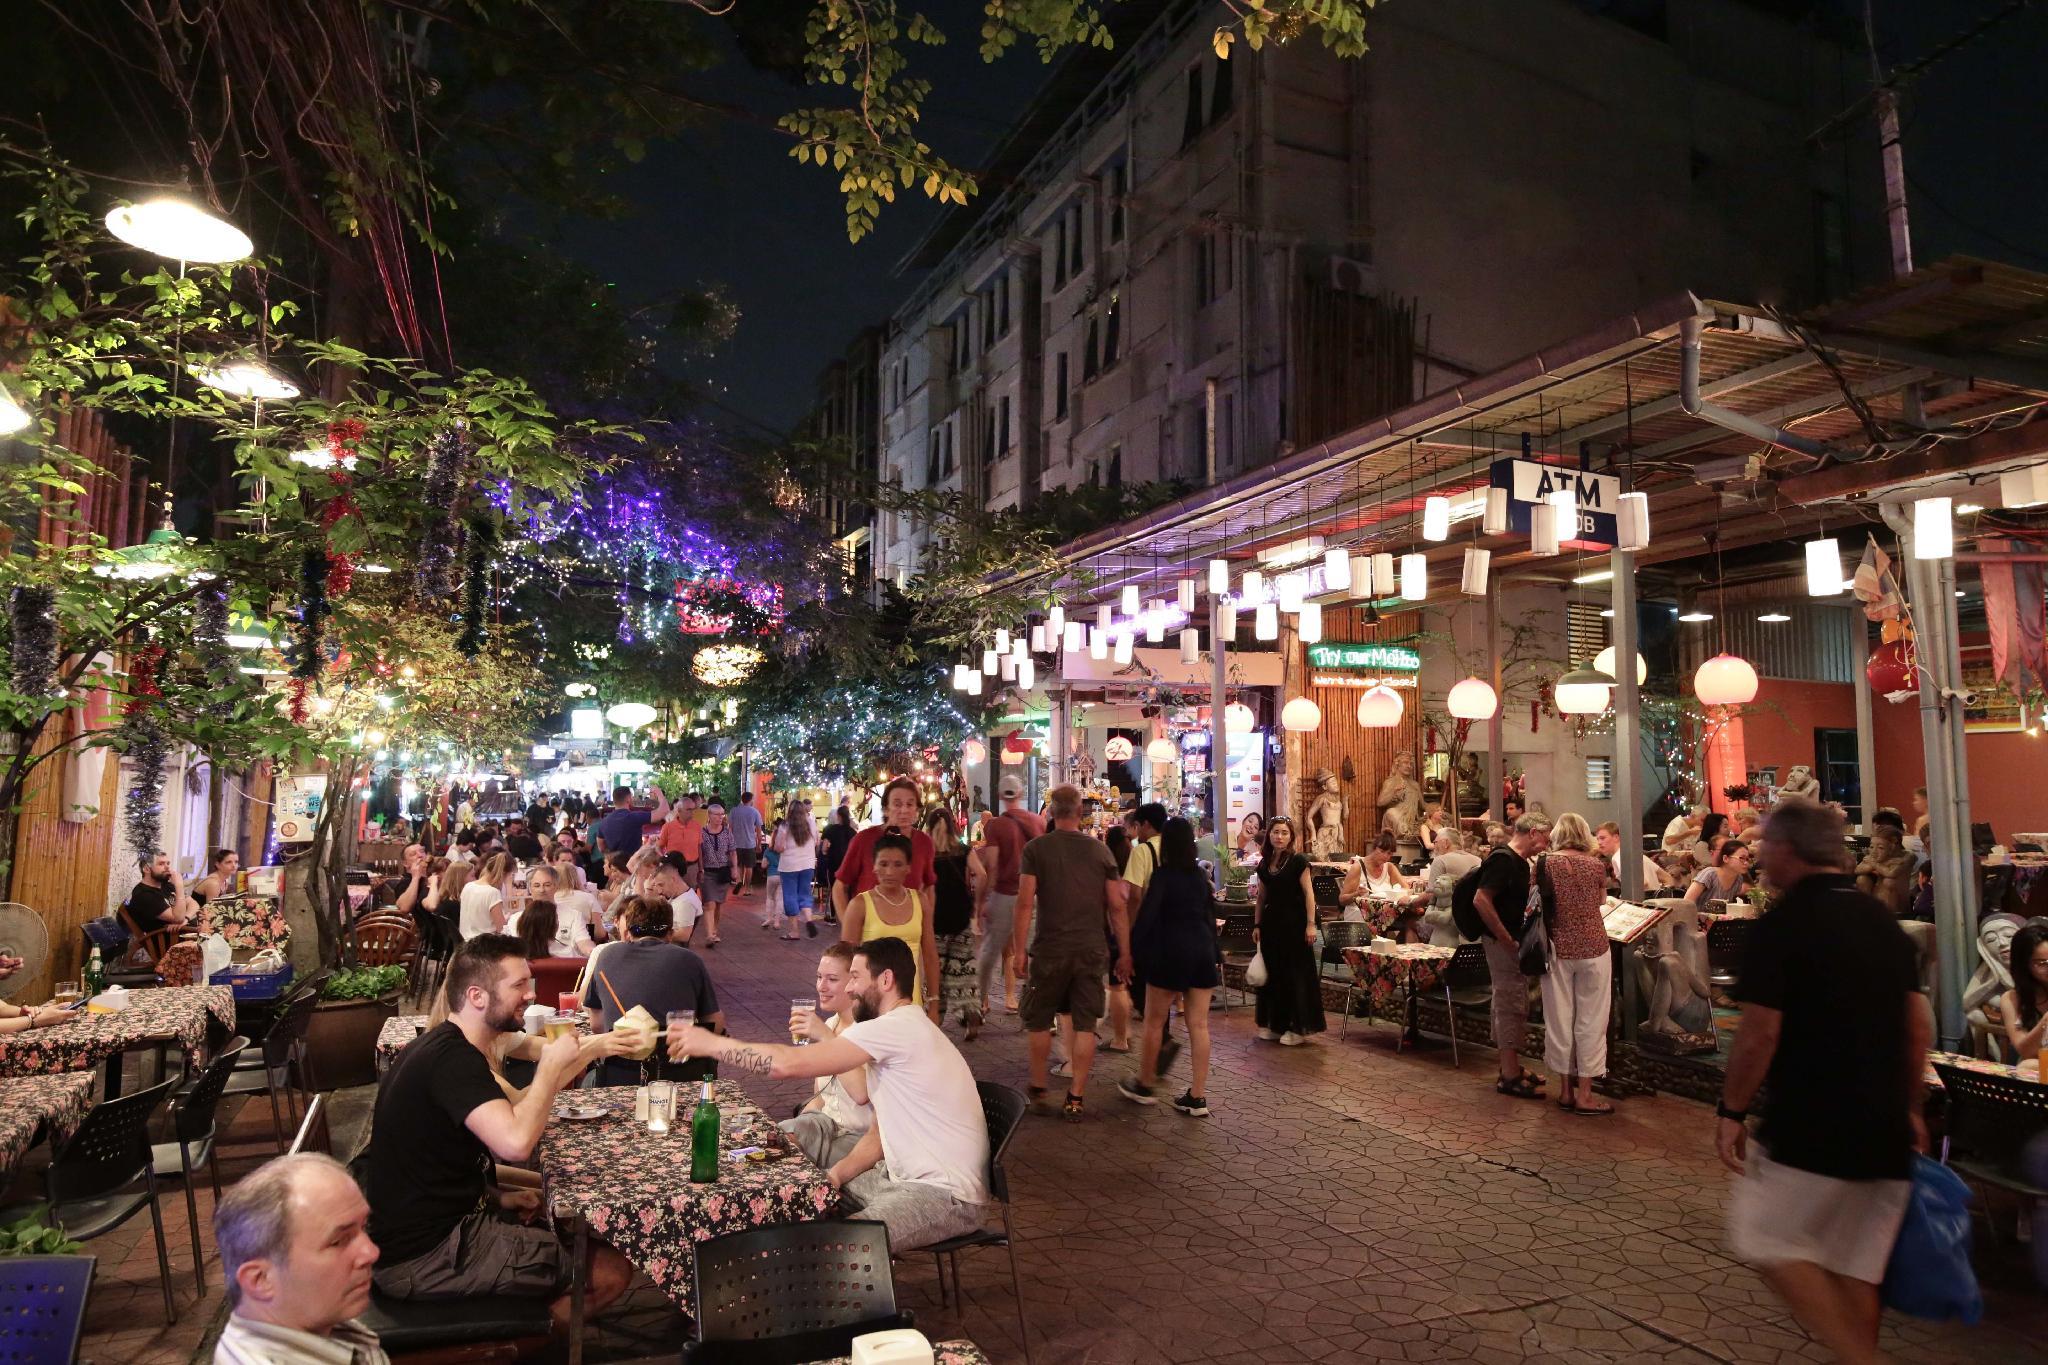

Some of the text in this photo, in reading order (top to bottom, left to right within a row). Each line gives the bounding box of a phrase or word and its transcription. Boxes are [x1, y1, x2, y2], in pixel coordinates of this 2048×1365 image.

[1536, 469, 1601, 507] ATM
[1310, 647, 1341, 666] Try
[1342, 651, 1371, 665] our
